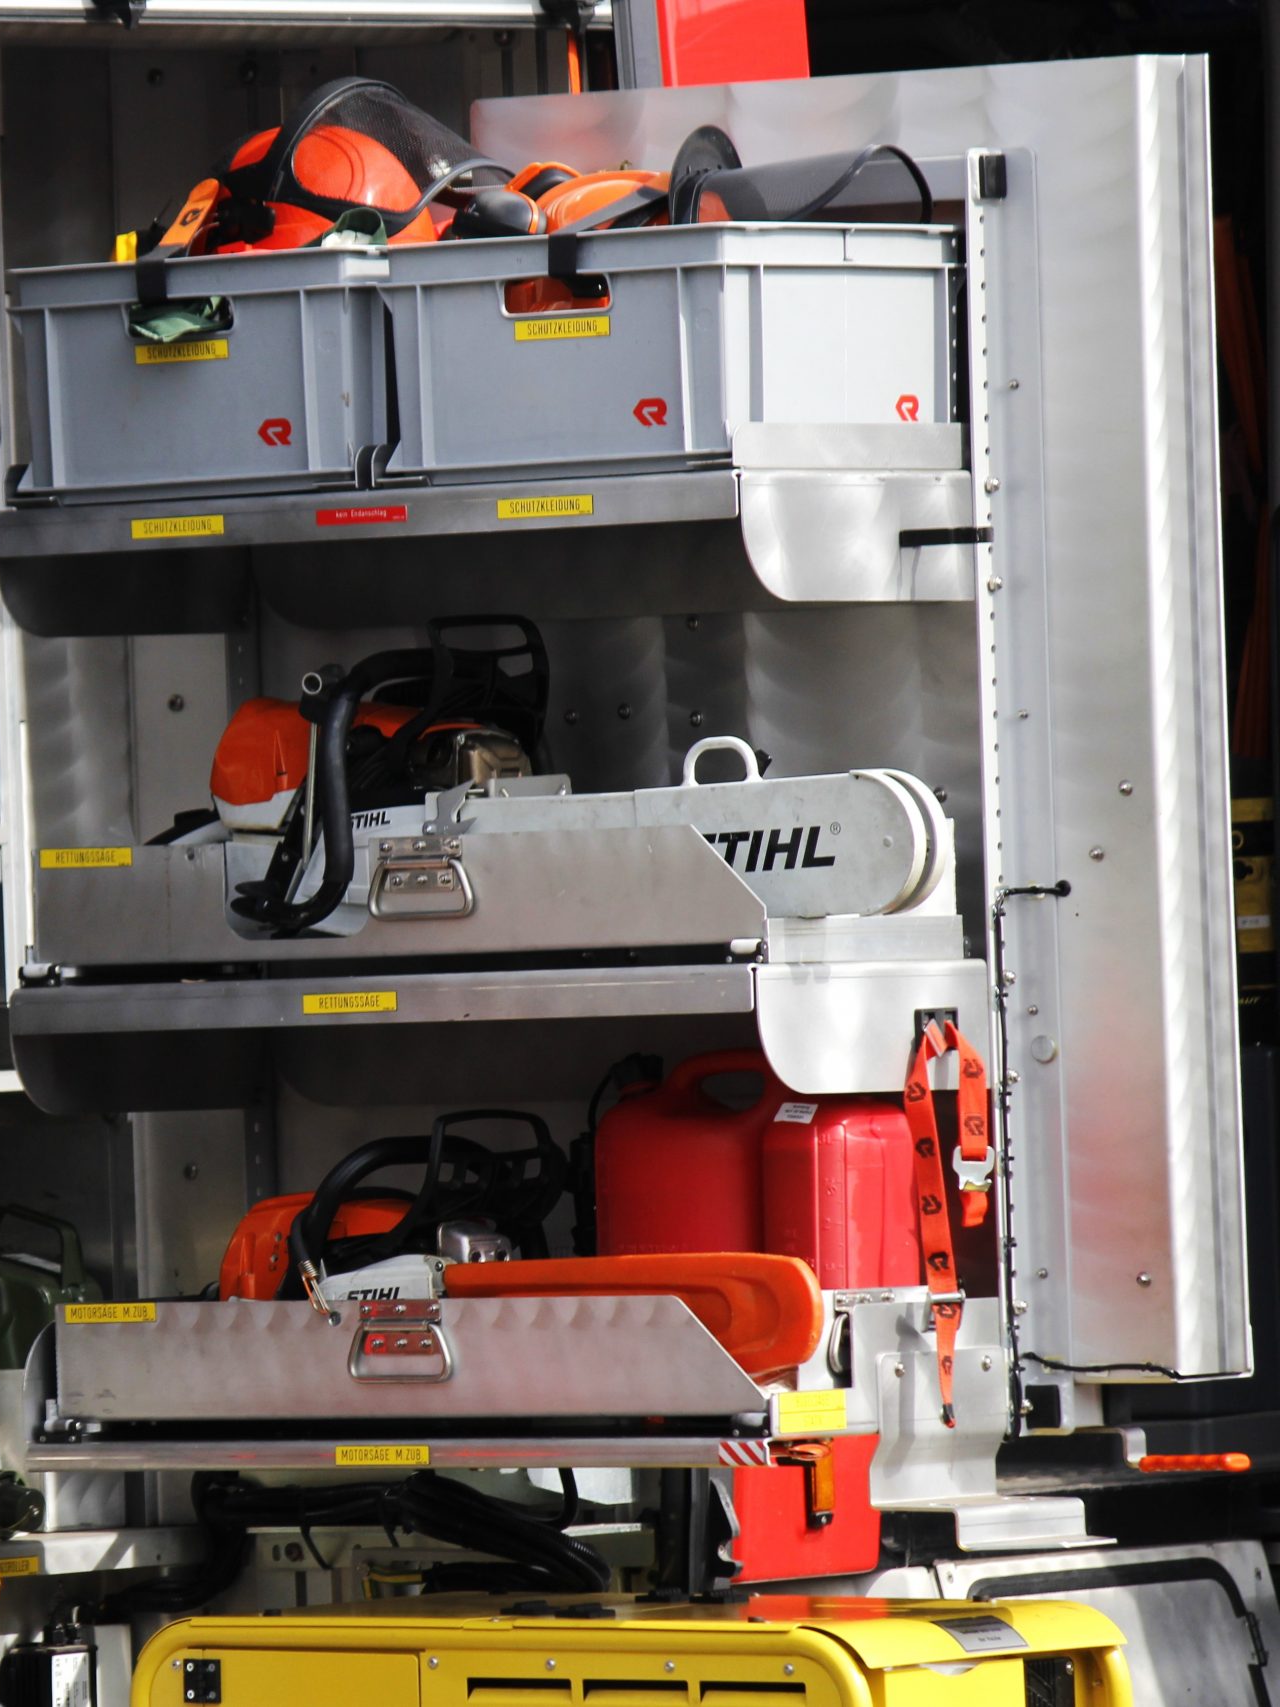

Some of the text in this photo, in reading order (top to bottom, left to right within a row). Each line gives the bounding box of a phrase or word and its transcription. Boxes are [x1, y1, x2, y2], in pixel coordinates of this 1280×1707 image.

[526, 319, 598, 336] SCHUTZKLEIDUNG
[147, 342, 216, 360] SCHUTZKLEIDUNG
[335, 509, 348, 519] kein
[350, 508, 387, 519] Endanschlag
[509, 498, 580, 515] SCHUTZKLEIDUNG
[143, 518, 212, 534] SCHUTZKLEIDUNG
[350, 811, 391, 830] TIHL
[702, 826, 836, 873] TIHL
